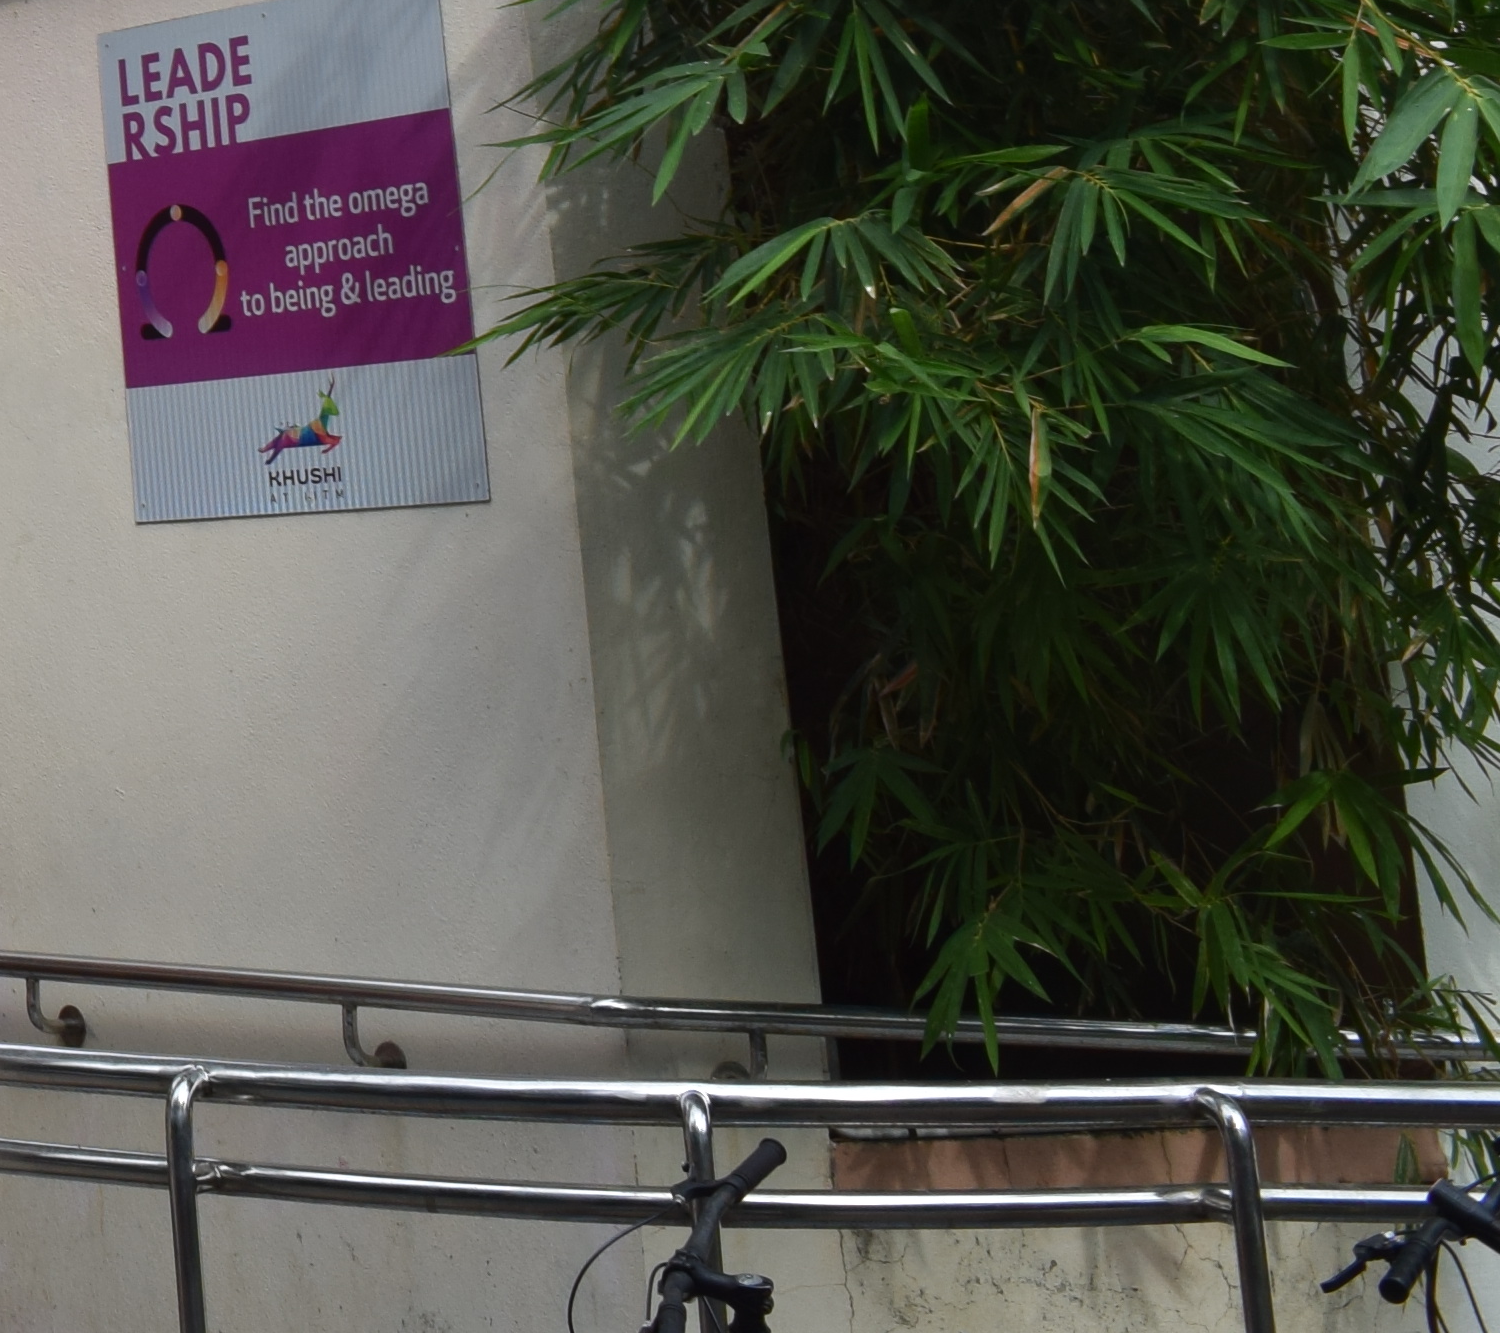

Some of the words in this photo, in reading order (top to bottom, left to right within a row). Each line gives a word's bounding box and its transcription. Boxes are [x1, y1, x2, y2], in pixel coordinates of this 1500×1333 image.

[118, 35, 252, 107] LEADE
[122, 93, 251, 161] RSHIP
[248, 191, 299, 228] Find
[304, 188, 343, 221] the
[348, 182, 429, 218] omega
[284, 224, 394, 276] approach
[240, 289, 265, 317] to
[269, 280, 337, 318] being
[340, 272, 362, 305] &
[365, 265, 457, 304] leading
[268, 466, 342, 488] KHUSHI
[270, 491, 289, 504] AT
